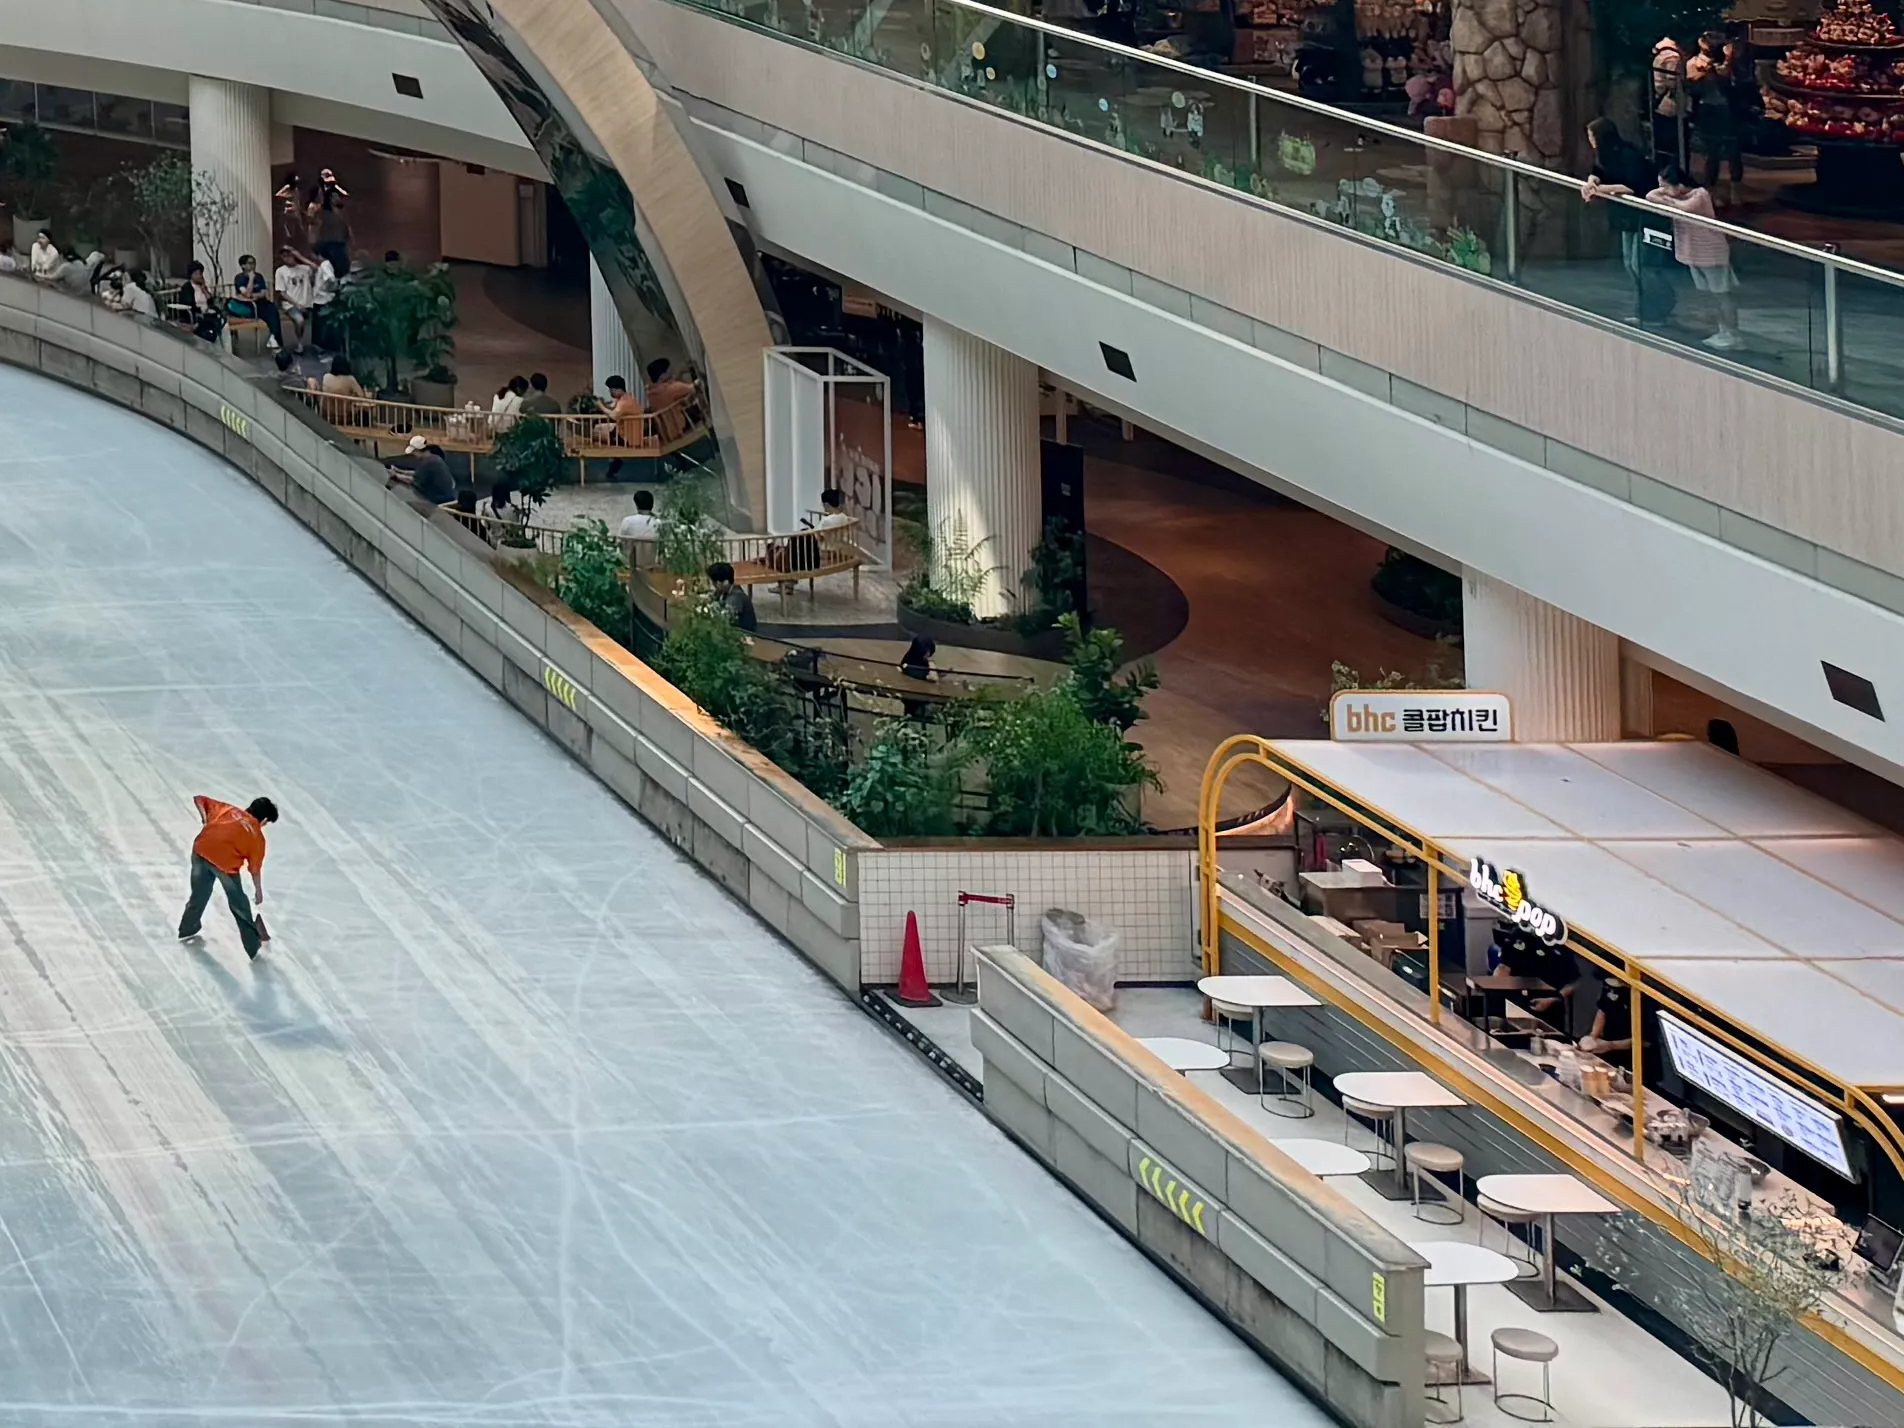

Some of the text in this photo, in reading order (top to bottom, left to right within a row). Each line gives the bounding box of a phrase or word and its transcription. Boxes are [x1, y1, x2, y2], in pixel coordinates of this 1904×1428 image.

[1346, 703, 1498, 733] bhc 콜팝치킨
[1469, 857, 1558, 937] bhc pop
